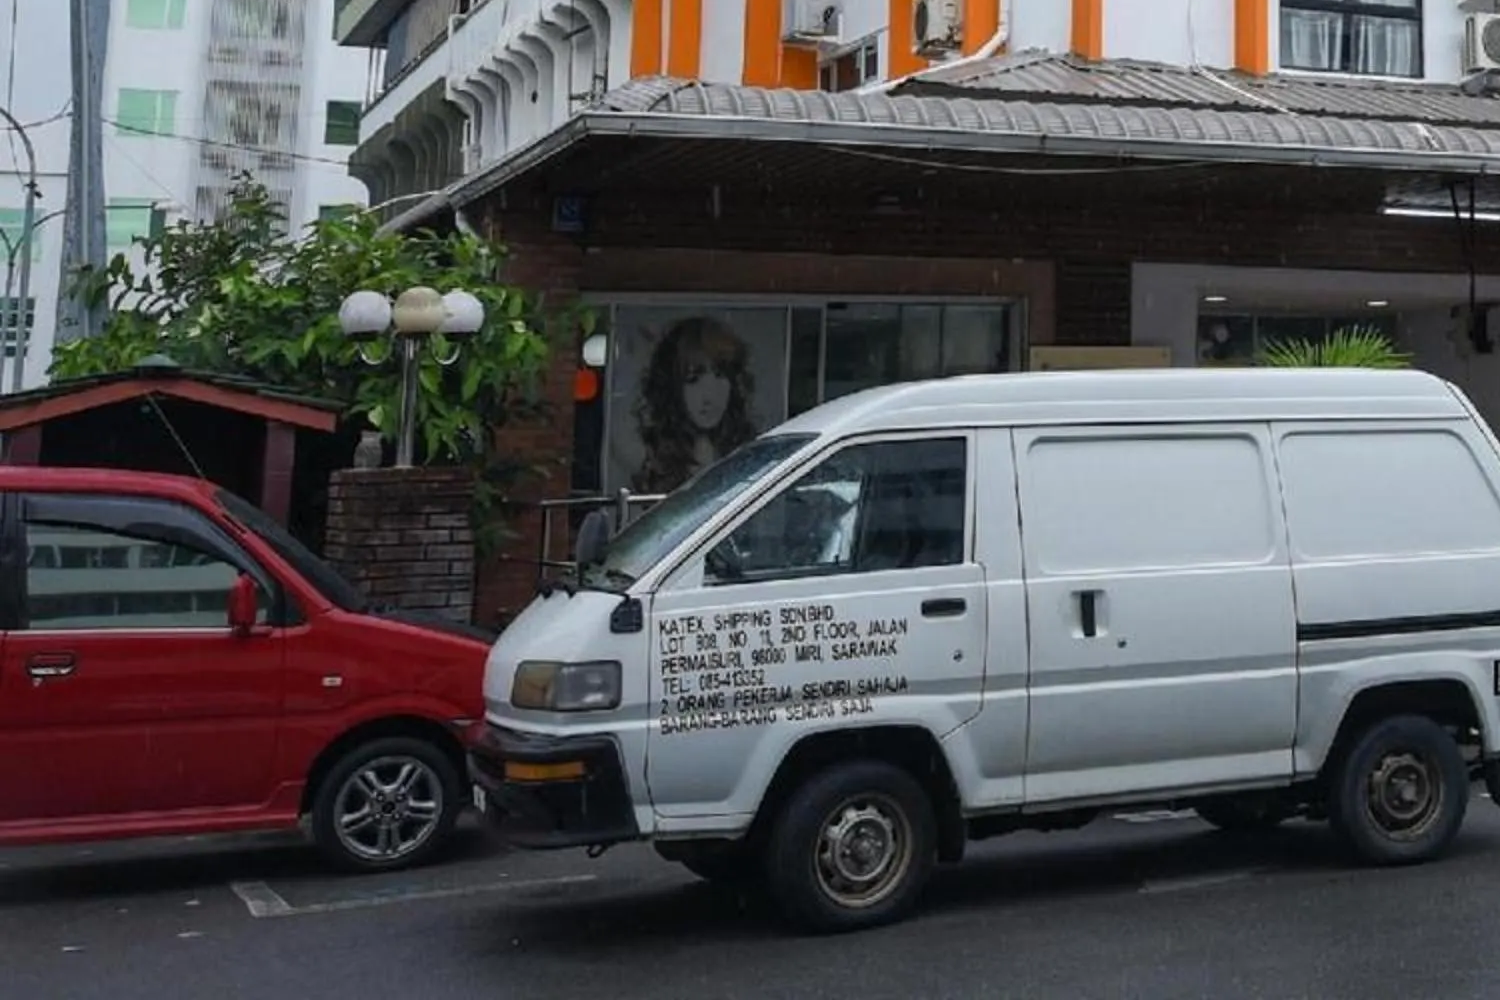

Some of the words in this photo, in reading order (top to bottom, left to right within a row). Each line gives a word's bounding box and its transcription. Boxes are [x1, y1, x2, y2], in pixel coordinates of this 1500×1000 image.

[659, 615, 705, 636] KATEX
[713, 608, 772, 631] SHIPPING
[660, 636, 686, 655] LOT
[781, 625, 807, 644] 2ND
[867, 616, 908, 637] JALAN
[831, 638, 898, 661] SARAWAK
[660, 697, 669, 715] 2
[677, 690, 725, 713] ORANG
[733, 684, 792, 708] PEKERJA
[801, 678, 852, 700] SENDIRI
[857, 674, 908, 696] SAHAJA
